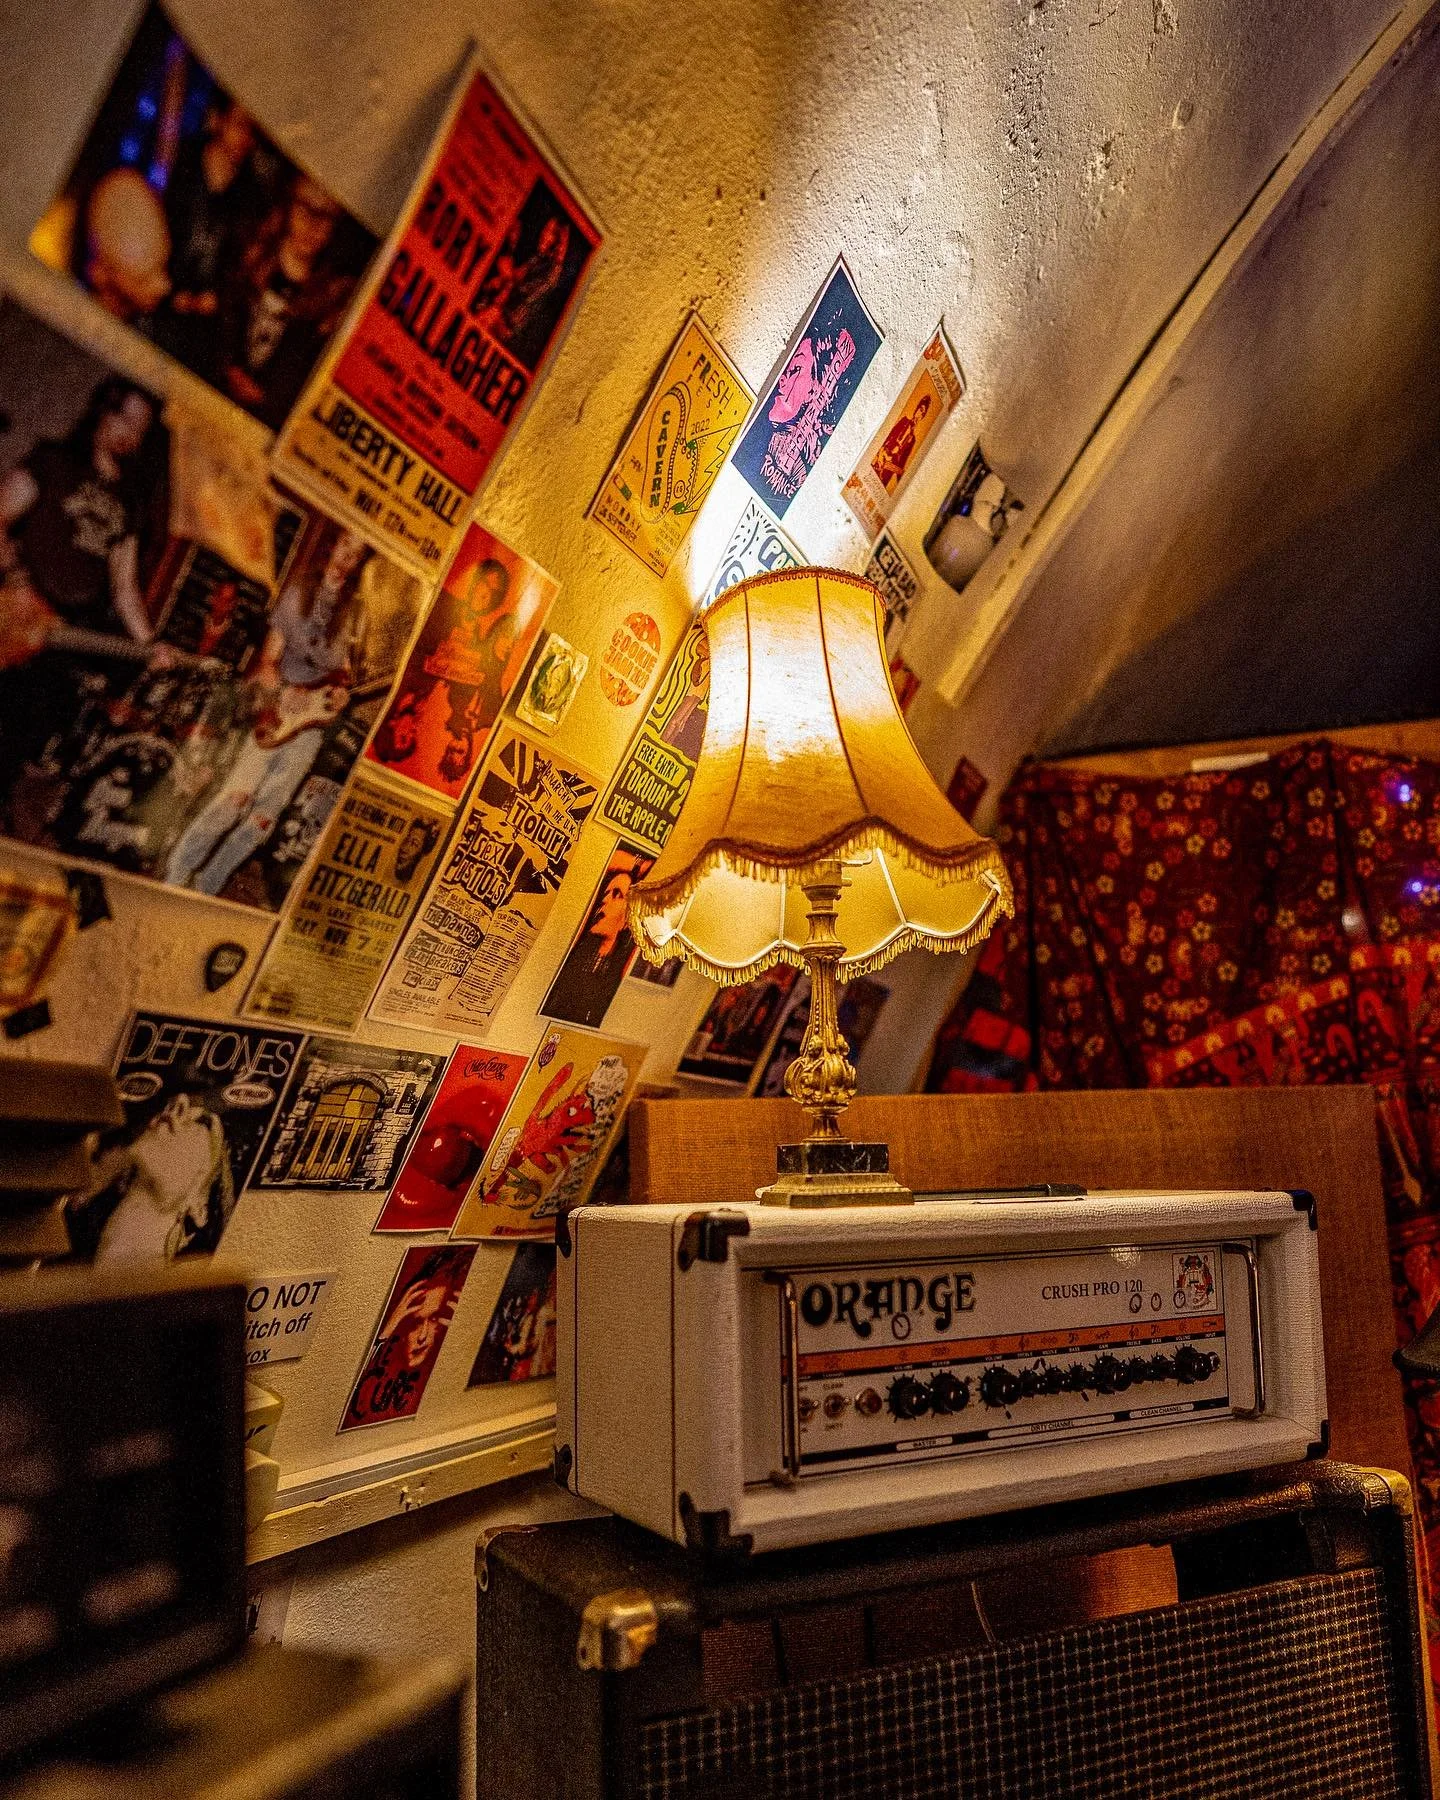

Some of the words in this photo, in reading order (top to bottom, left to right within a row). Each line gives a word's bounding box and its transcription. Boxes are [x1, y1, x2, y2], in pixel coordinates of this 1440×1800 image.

[417, 182, 491, 284] RORY
[379, 250, 528, 425] GALLAGHER
[693, 352, 735, 410] FRESH
[690, 418, 710, 435] 2022
[312, 402, 416, 486] LIBERTY
[415, 470, 462, 527] HALL
[648, 410, 672, 508] CAVERN
[760, 454, 797, 499] ROMANCE
[606, 494, 642, 532] MONDAY
[611, 629, 658, 674] COOKIE
[638, 743, 656, 769] FREE
[654, 754, 679, 782] ENTRY
[544, 767, 572, 806] ANARCHY
[620, 761, 673, 812] TORQUAY
[545, 801, 551, 814] IN
[552, 808, 564, 825] THE
[608, 793, 634, 825] THE
[332, 832, 382, 875] ELLA
[308, 864, 412, 919] FITZGERALD
[426, 909, 445, 927] THE
[411, 992, 441, 1006] AVAILABLE
[123, 1019, 295, 1079] DEFTONES
[246, 1286, 270, 1312] O
[273, 1280, 327, 1310] NOT
[801, 1272, 976, 1338] ORANGE
[1041, 1283, 1090, 1300] CRUSH
[1093, 1281, 1120, 1296] PRO
[1124, 1279, 1143, 1293] 120
[245, 1317, 281, 1340] itch
[285, 1311, 313, 1335] off
[247, 1348, 271, 1364] ox
